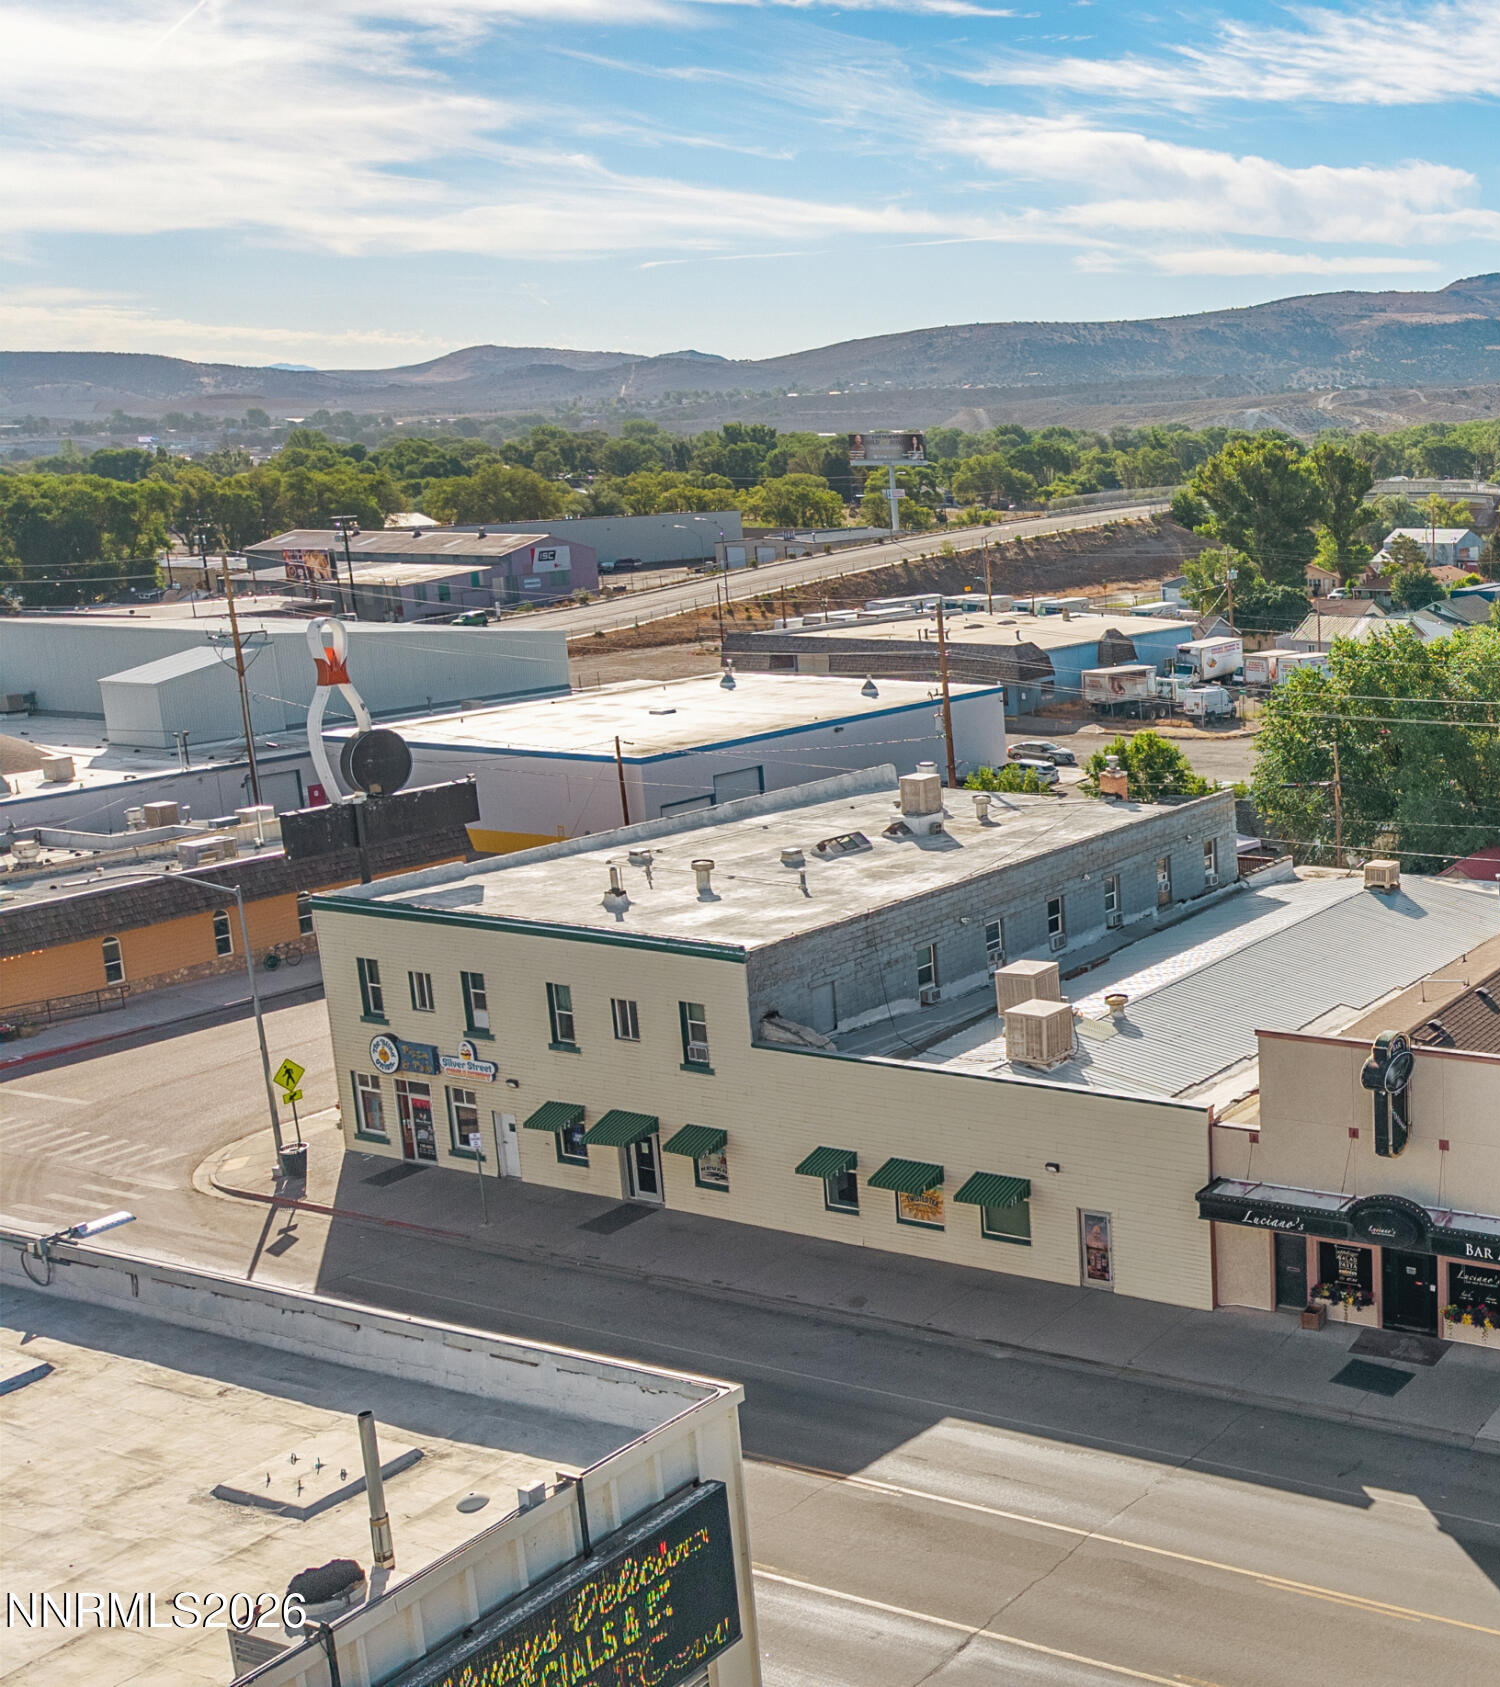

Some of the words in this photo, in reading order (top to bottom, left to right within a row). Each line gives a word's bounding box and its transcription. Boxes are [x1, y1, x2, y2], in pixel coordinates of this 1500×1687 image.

[442, 1057, 466, 1069] Silver
[467, 1061, 492, 1073] Street
[1241, 1210, 1305, 1231] Luciano's
[1465, 1243, 1494, 1260] BAR
